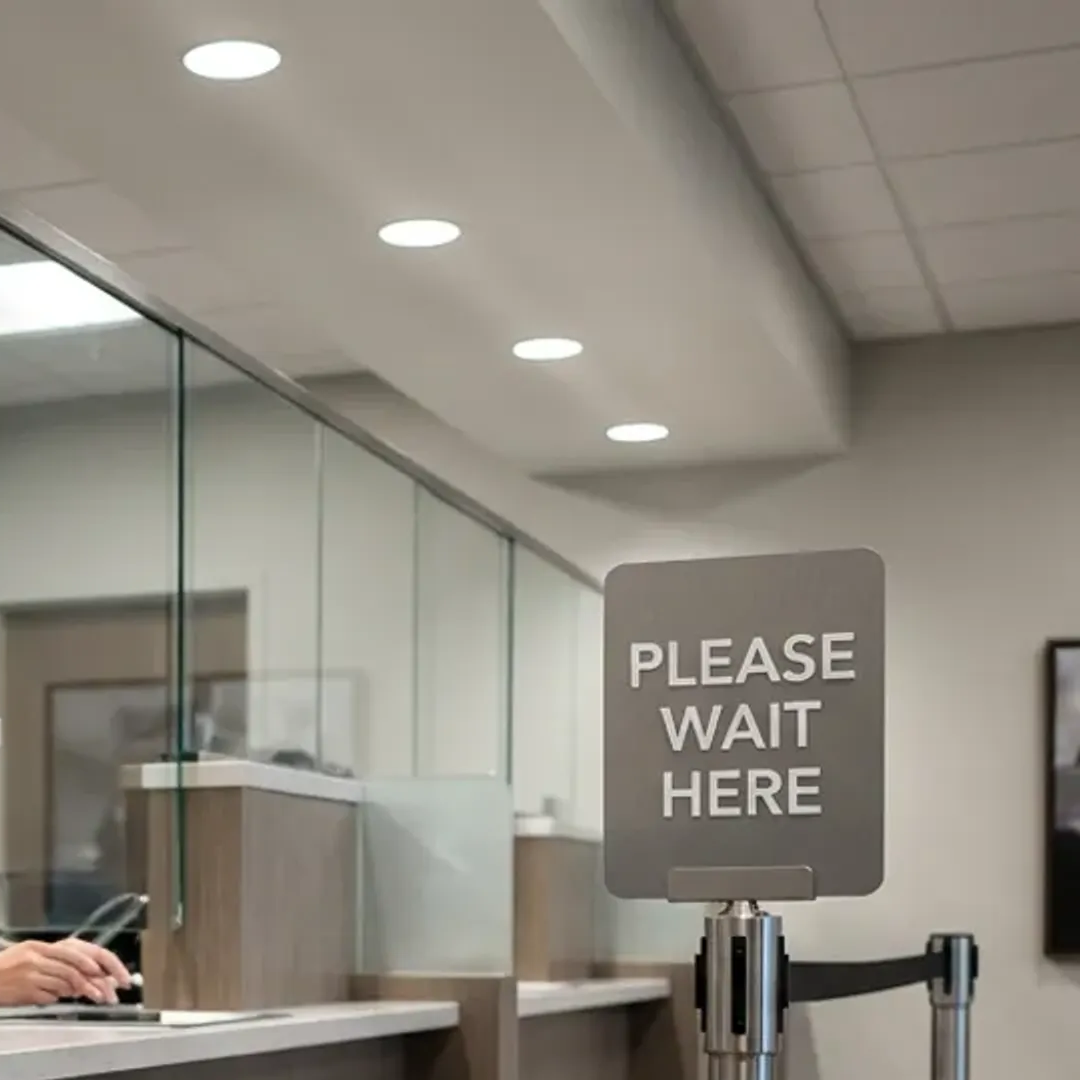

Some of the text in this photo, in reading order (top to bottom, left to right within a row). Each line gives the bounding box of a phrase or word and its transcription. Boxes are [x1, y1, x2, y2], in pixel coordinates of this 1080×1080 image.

[629, 631, 857, 688] PLEASE
[661, 700, 822, 752] WAIT
[662, 767, 822, 818] HERE
